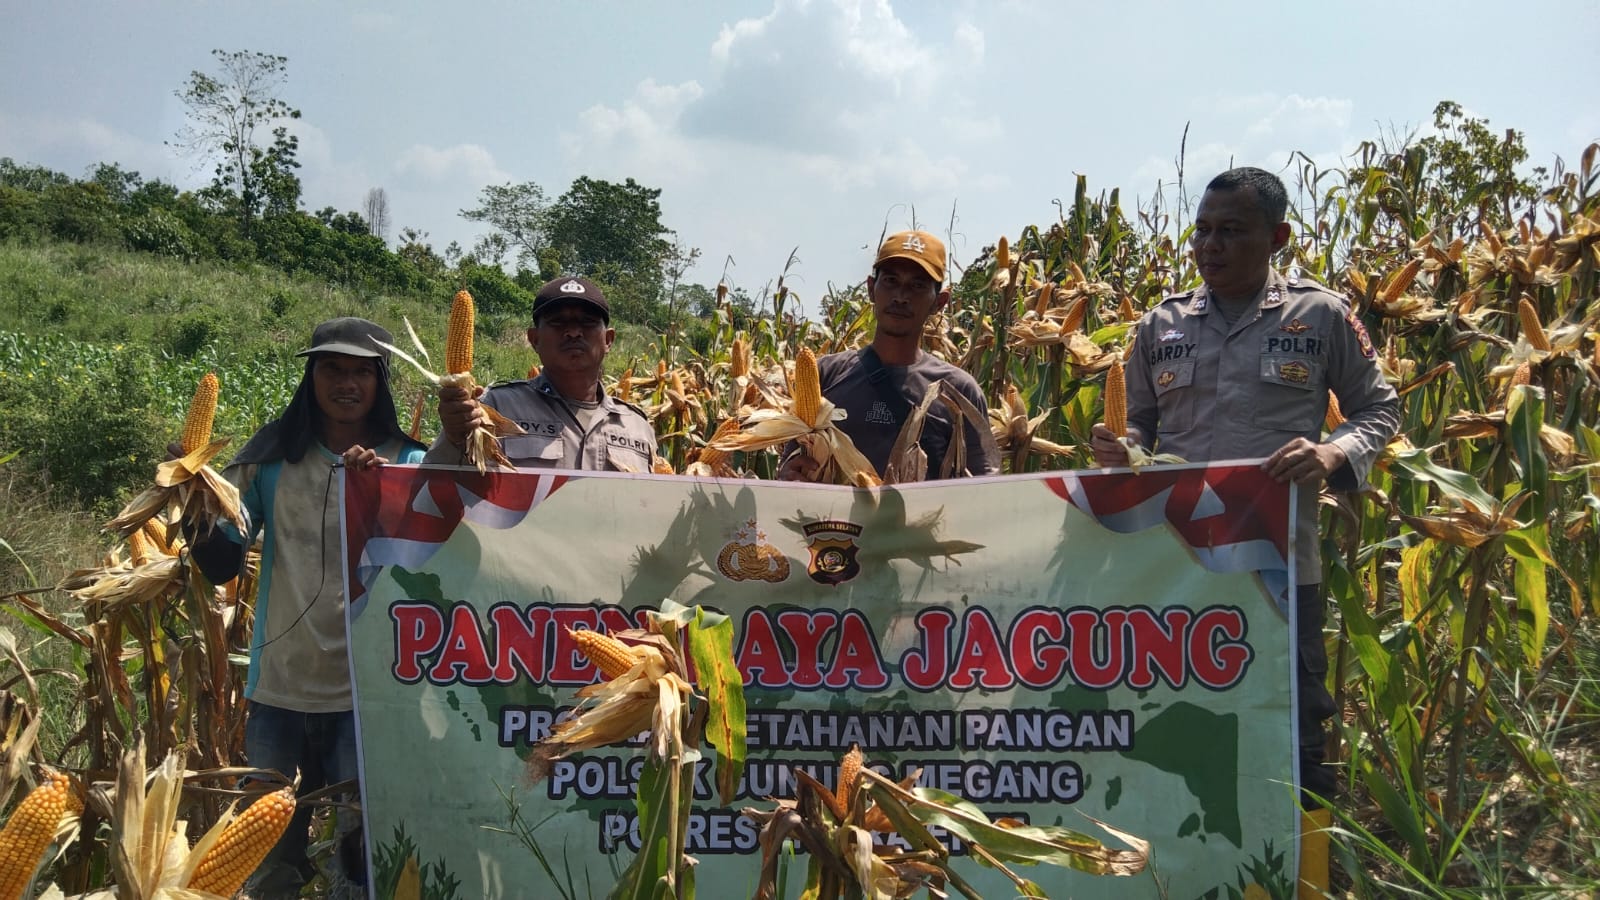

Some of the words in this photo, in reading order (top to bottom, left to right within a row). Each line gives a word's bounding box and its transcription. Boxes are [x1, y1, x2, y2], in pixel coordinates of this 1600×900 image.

[1268, 337, 1322, 355] POLRI
[610, 434, 646, 451] POLRI
[681, 608, 889, 689] AYA
[902, 609, 1250, 689] JAGUNG
[745, 713, 951, 747] ETAHANAN
[966, 713, 1130, 748] PANGAN
[905, 764, 1079, 799] MEGANG
